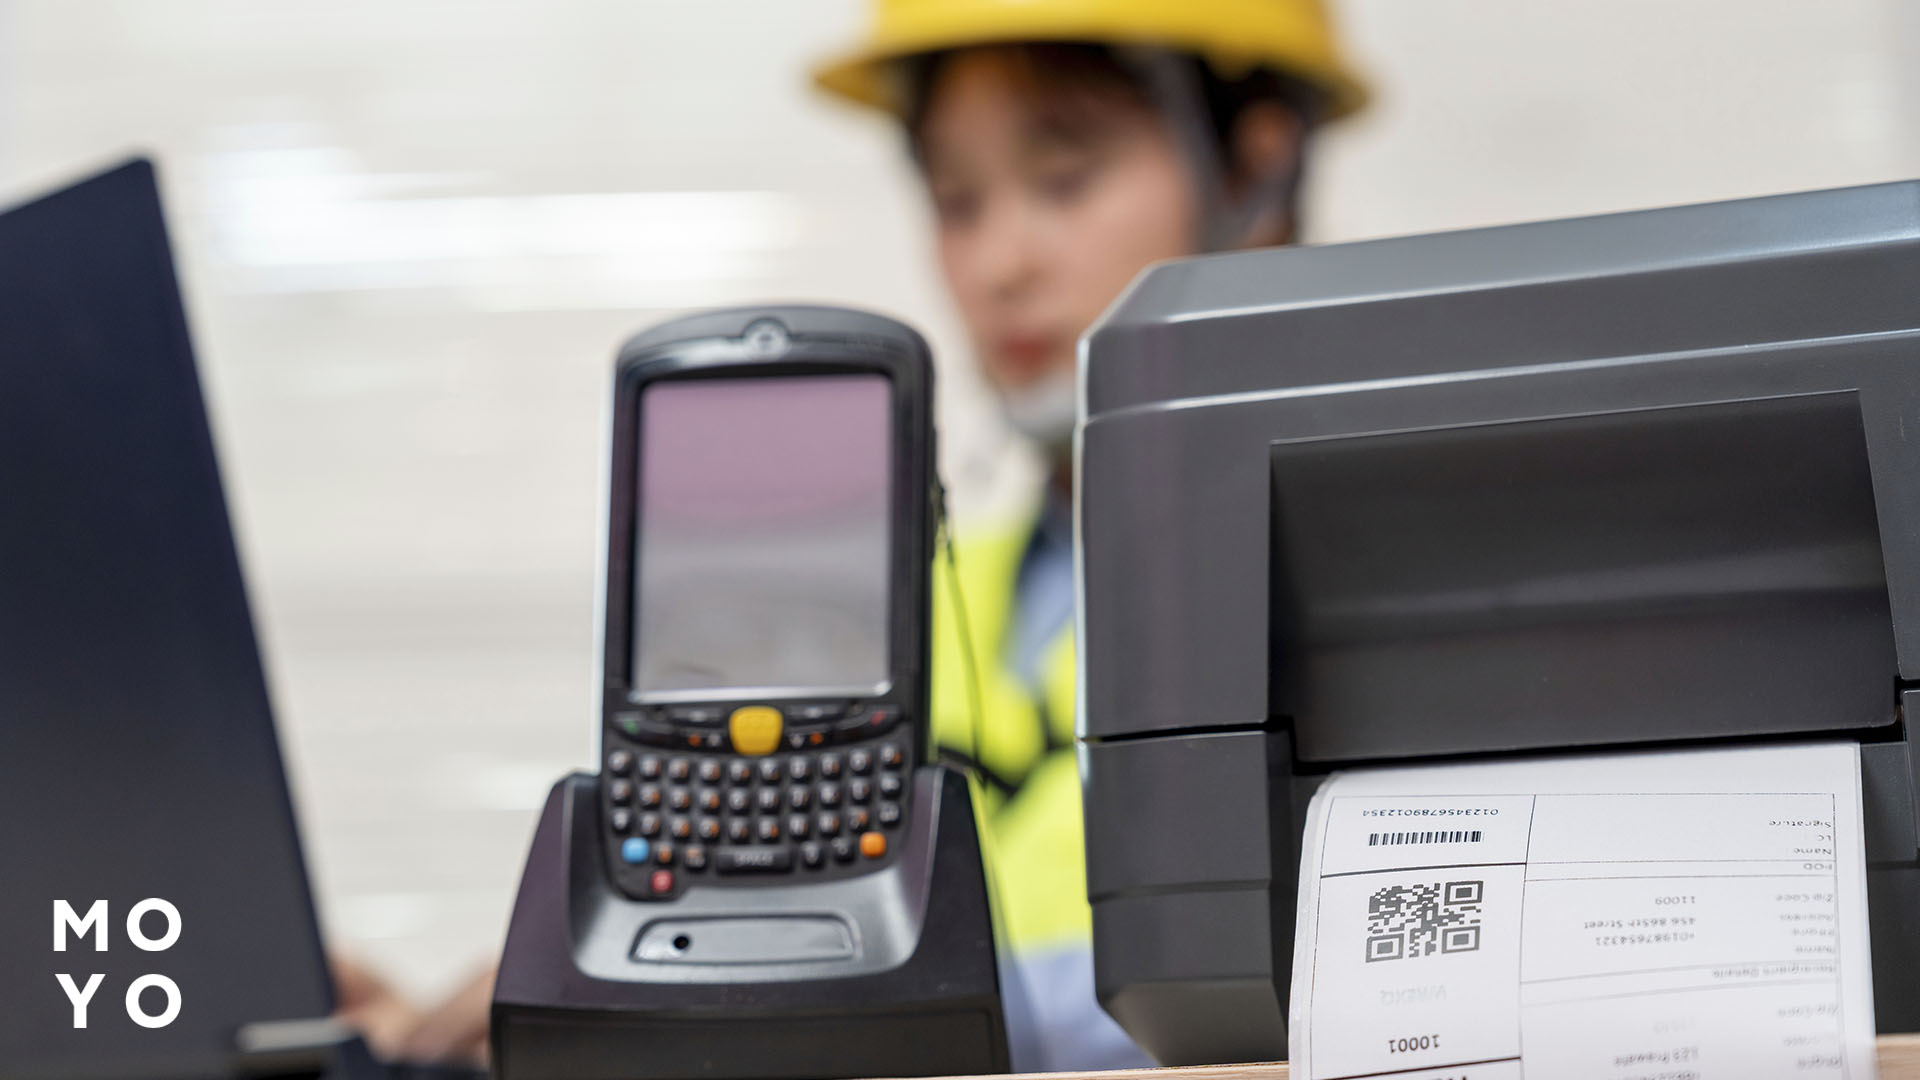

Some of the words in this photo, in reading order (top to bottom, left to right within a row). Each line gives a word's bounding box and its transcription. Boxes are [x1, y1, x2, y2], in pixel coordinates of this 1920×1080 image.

[1362, 808, 1499, 817] 0123456789012354
[1793, 847, 1832, 855] Name
[1655, 895, 1696, 905] 11009
[1584, 920, 1623, 930] Street
[1387, 1034, 1440, 1054] 10001
